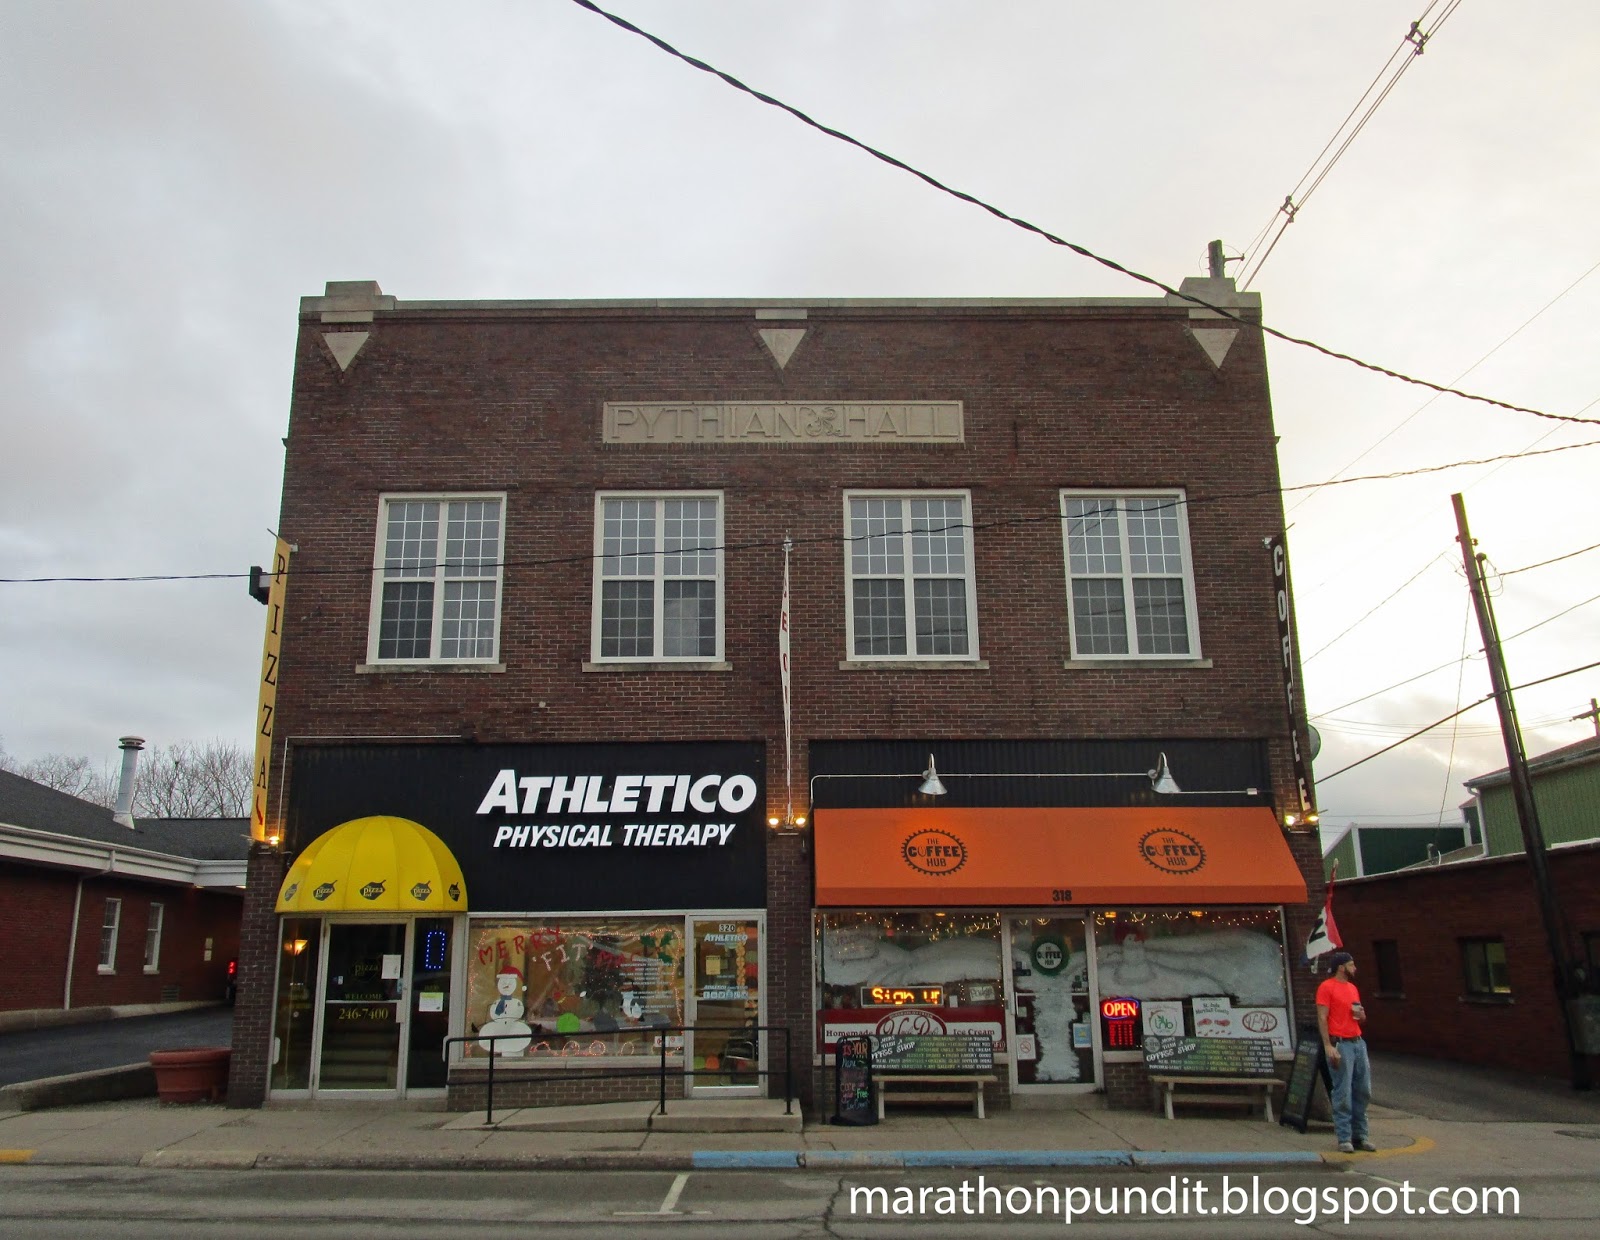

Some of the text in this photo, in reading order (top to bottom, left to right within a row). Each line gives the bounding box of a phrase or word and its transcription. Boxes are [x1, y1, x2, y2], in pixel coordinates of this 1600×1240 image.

[611, 405, 959, 438] PYTHIAN HALL
[256, 553, 286, 790] PIZZA
[1273, 544, 1311, 812] COFFEE
[475, 769, 758, 814] ATHLETICO
[493, 823, 736, 848] PHYSICAL THERAPY
[907, 845, 961, 858] COFFEE
[1145, 844, 1200, 857] COFFEE
[926, 858, 947, 867] HUB
[1166, 857, 1188, 866] HUB
[1052, 890, 1073, 902] 318
[719, 924, 735, 932] 320
[704, 933, 748, 942] ATHLETICO
[478, 925, 562, 965] MERRY
[871, 987, 915, 1005] Sign
[338, 1008, 389, 1020] 246-7400
[1103, 1002, 1137, 1017] OPEN
[826, 1028, 995, 1037] Homemade Ice Cream
[896, 1041, 915, 1053] SHOP
[1177, 1043, 1197, 1054] SHOP
